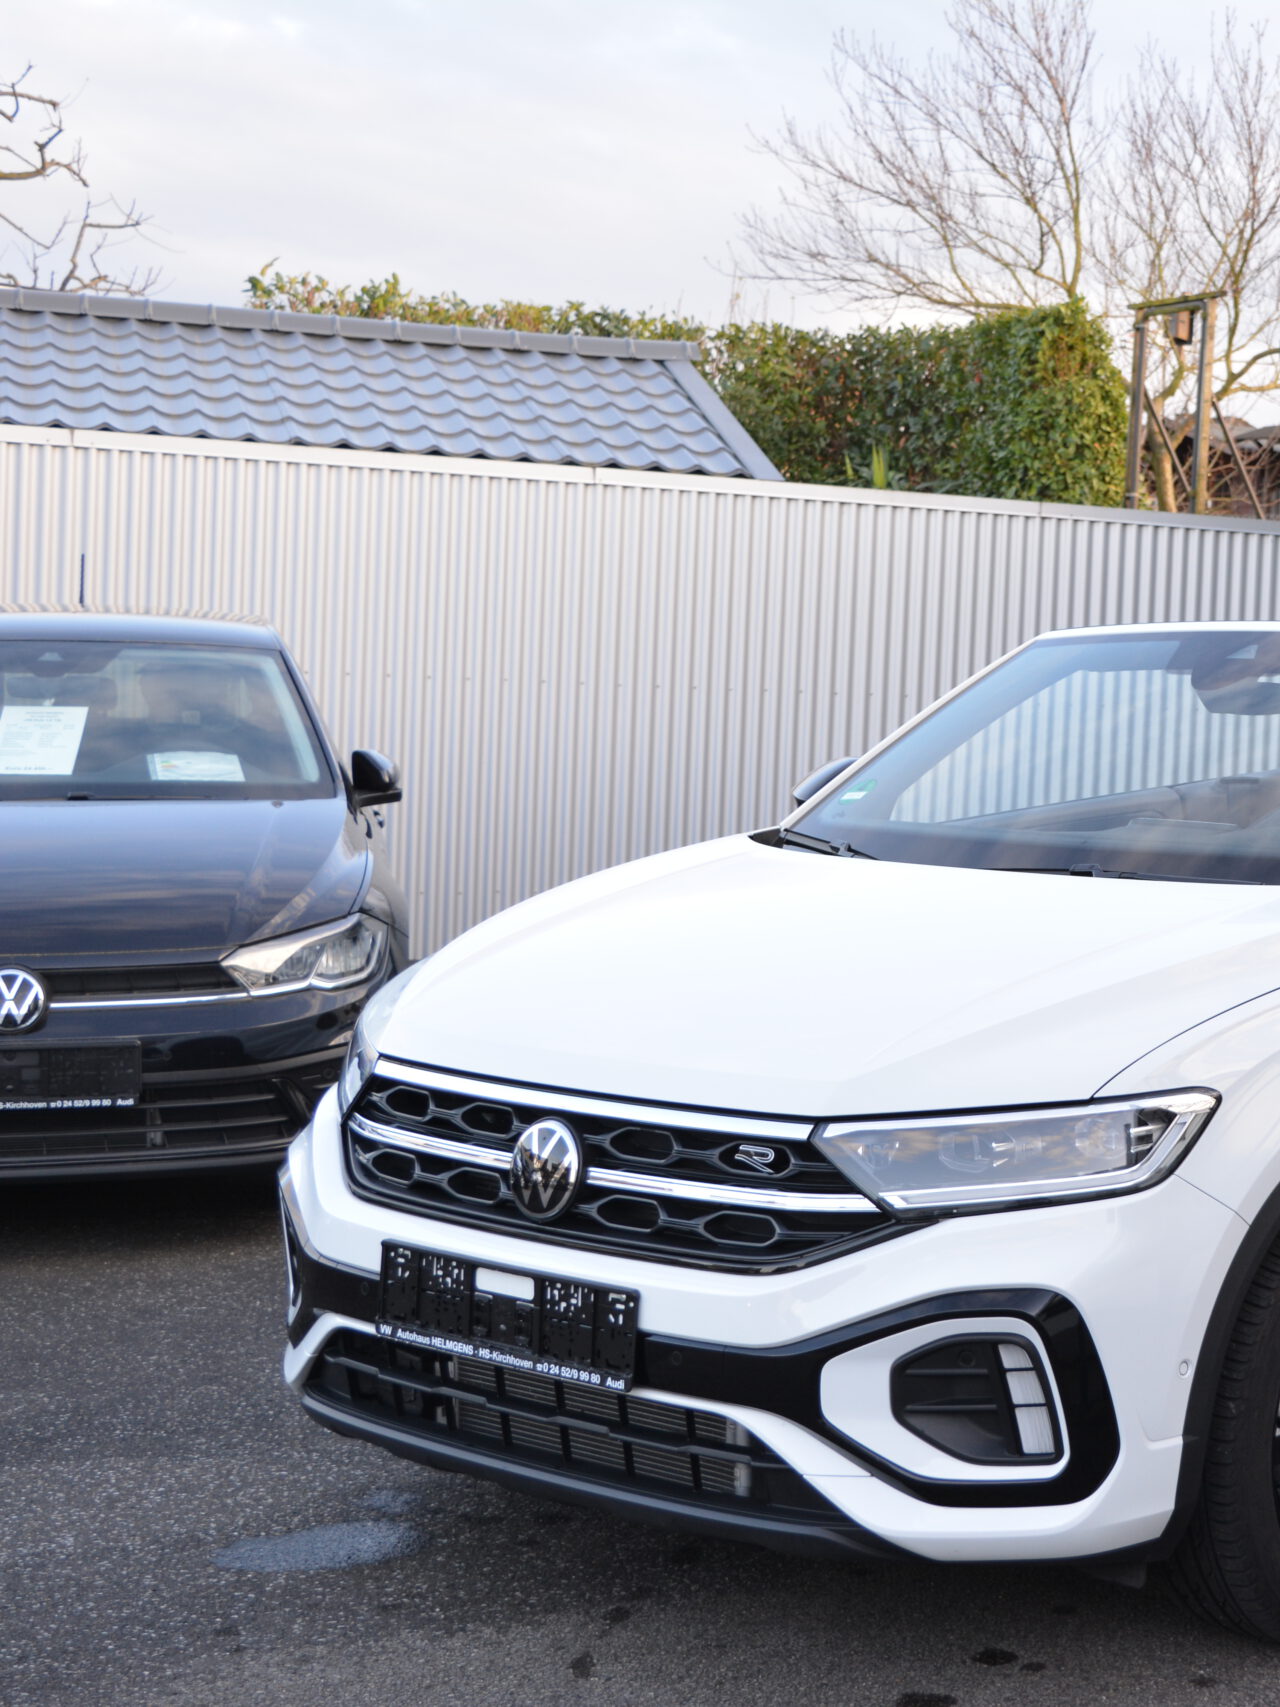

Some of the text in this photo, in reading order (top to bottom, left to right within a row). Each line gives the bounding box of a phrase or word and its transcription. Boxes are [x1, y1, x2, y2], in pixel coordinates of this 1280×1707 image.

[117, 1098, 134, 1106] Audi
[511, 1117, 581, 1220] VW
[735, 1144, 775, 1174] R
[380, 1323, 393, 1335] VW
[397, 1328, 430, 1345] Autohaus
[432, 1336, 474, 1355] HELMGENS
[479, 1347, 534, 1369] HS-Kirchhoven
[550, 1364, 560, 1375] 24
[561, 1367, 578, 1379] 52/9
[579, 1371, 590, 1382] 99
[591, 1373, 600, 1384] 80
[606, 1377, 625, 1390] Audi
